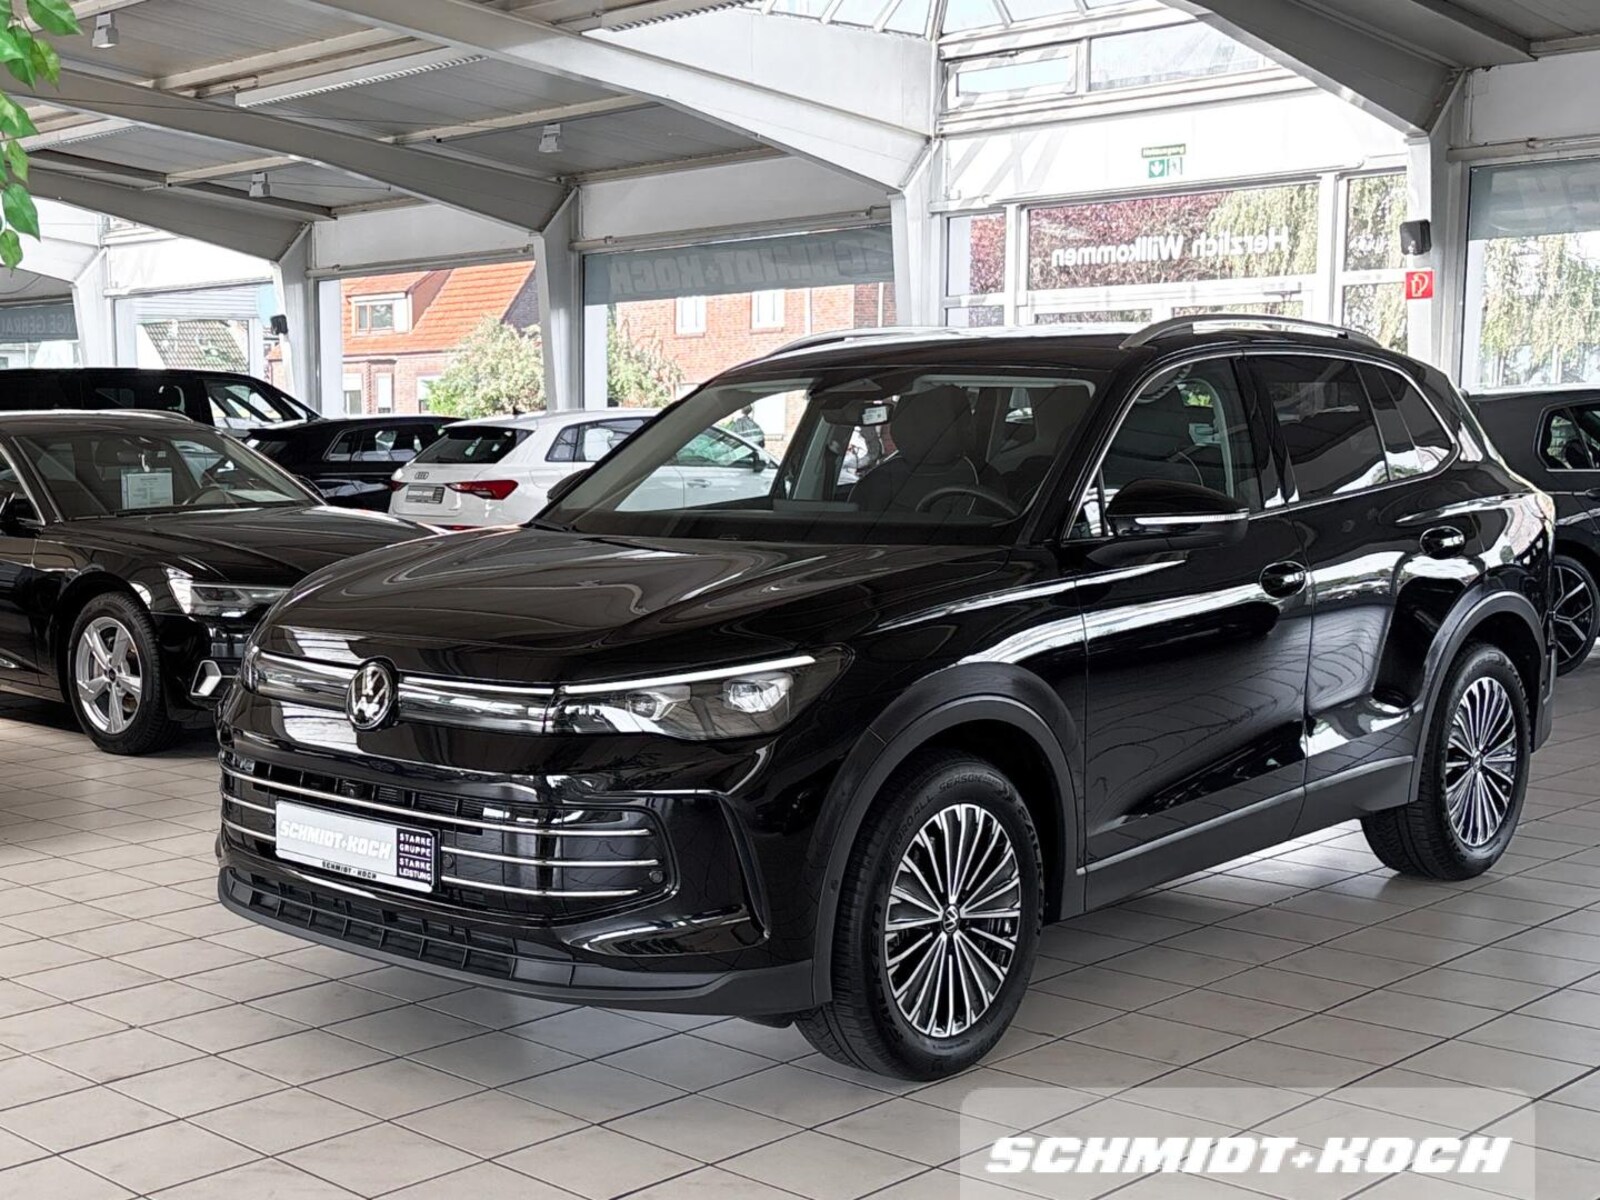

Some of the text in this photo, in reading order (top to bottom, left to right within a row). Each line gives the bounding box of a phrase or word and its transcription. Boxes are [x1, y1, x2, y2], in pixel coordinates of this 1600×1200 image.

[279, 820, 392, 860] SCHMIDT+KOCH
[399, 833, 431, 846] STARKE
[399, 843, 431, 857] GRUPPE
[399, 857, 431, 871] STARKE
[399, 867, 431, 881] LEISTUNG
